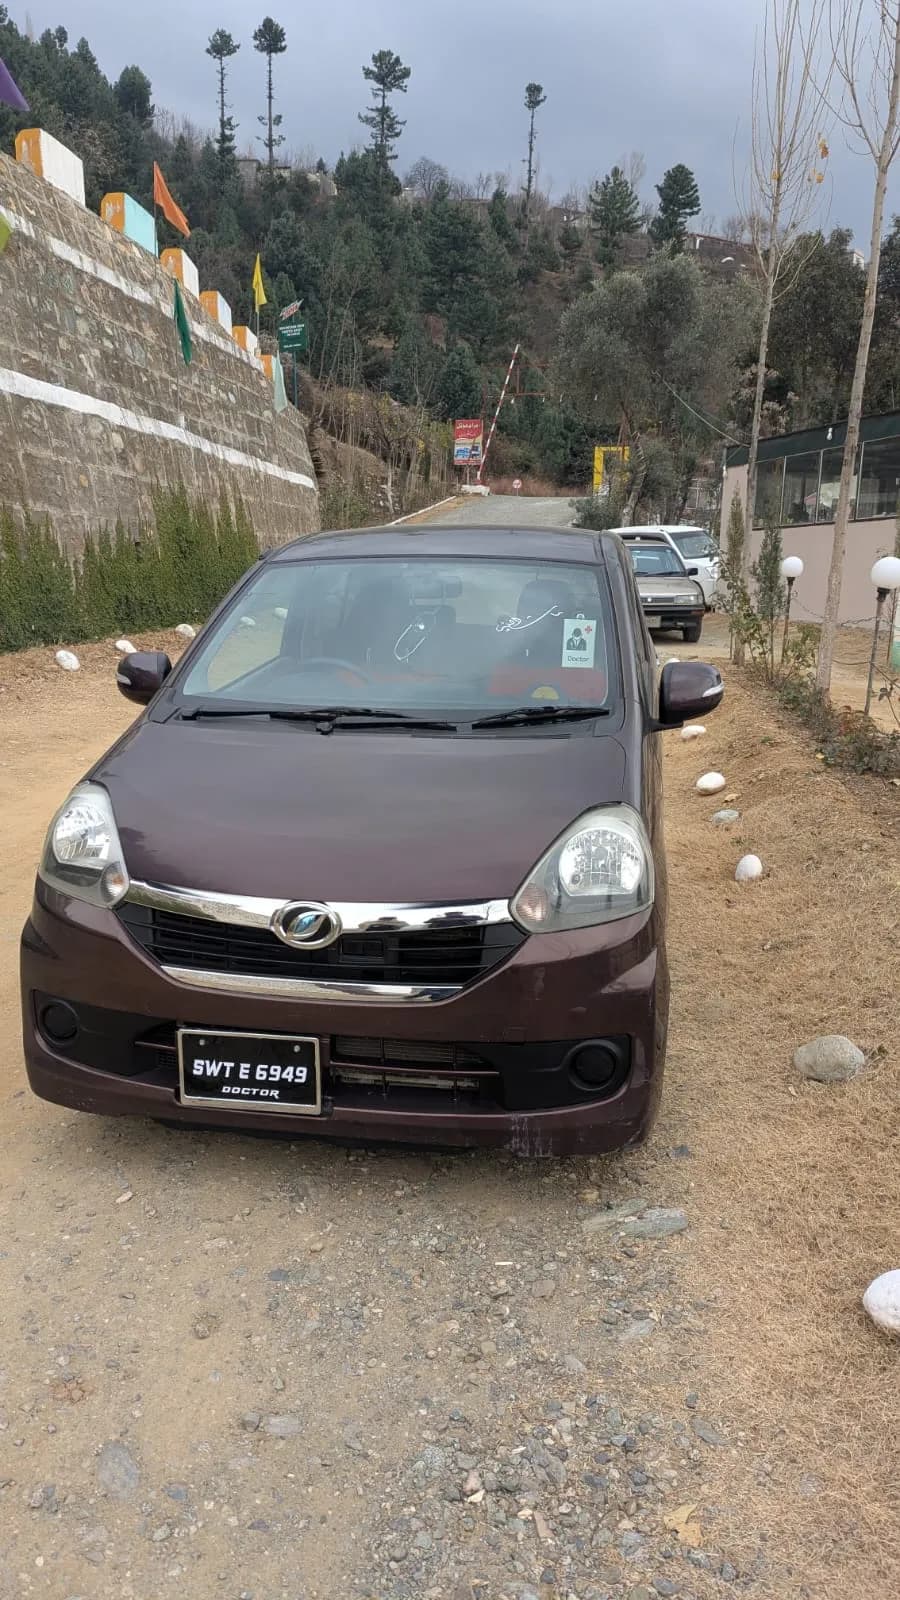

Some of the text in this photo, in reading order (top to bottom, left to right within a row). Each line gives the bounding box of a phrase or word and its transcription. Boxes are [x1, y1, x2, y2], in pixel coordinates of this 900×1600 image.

[192, 1059, 308, 1083] SWT E 6949
[221, 1086, 280, 1099] DOCTOR
